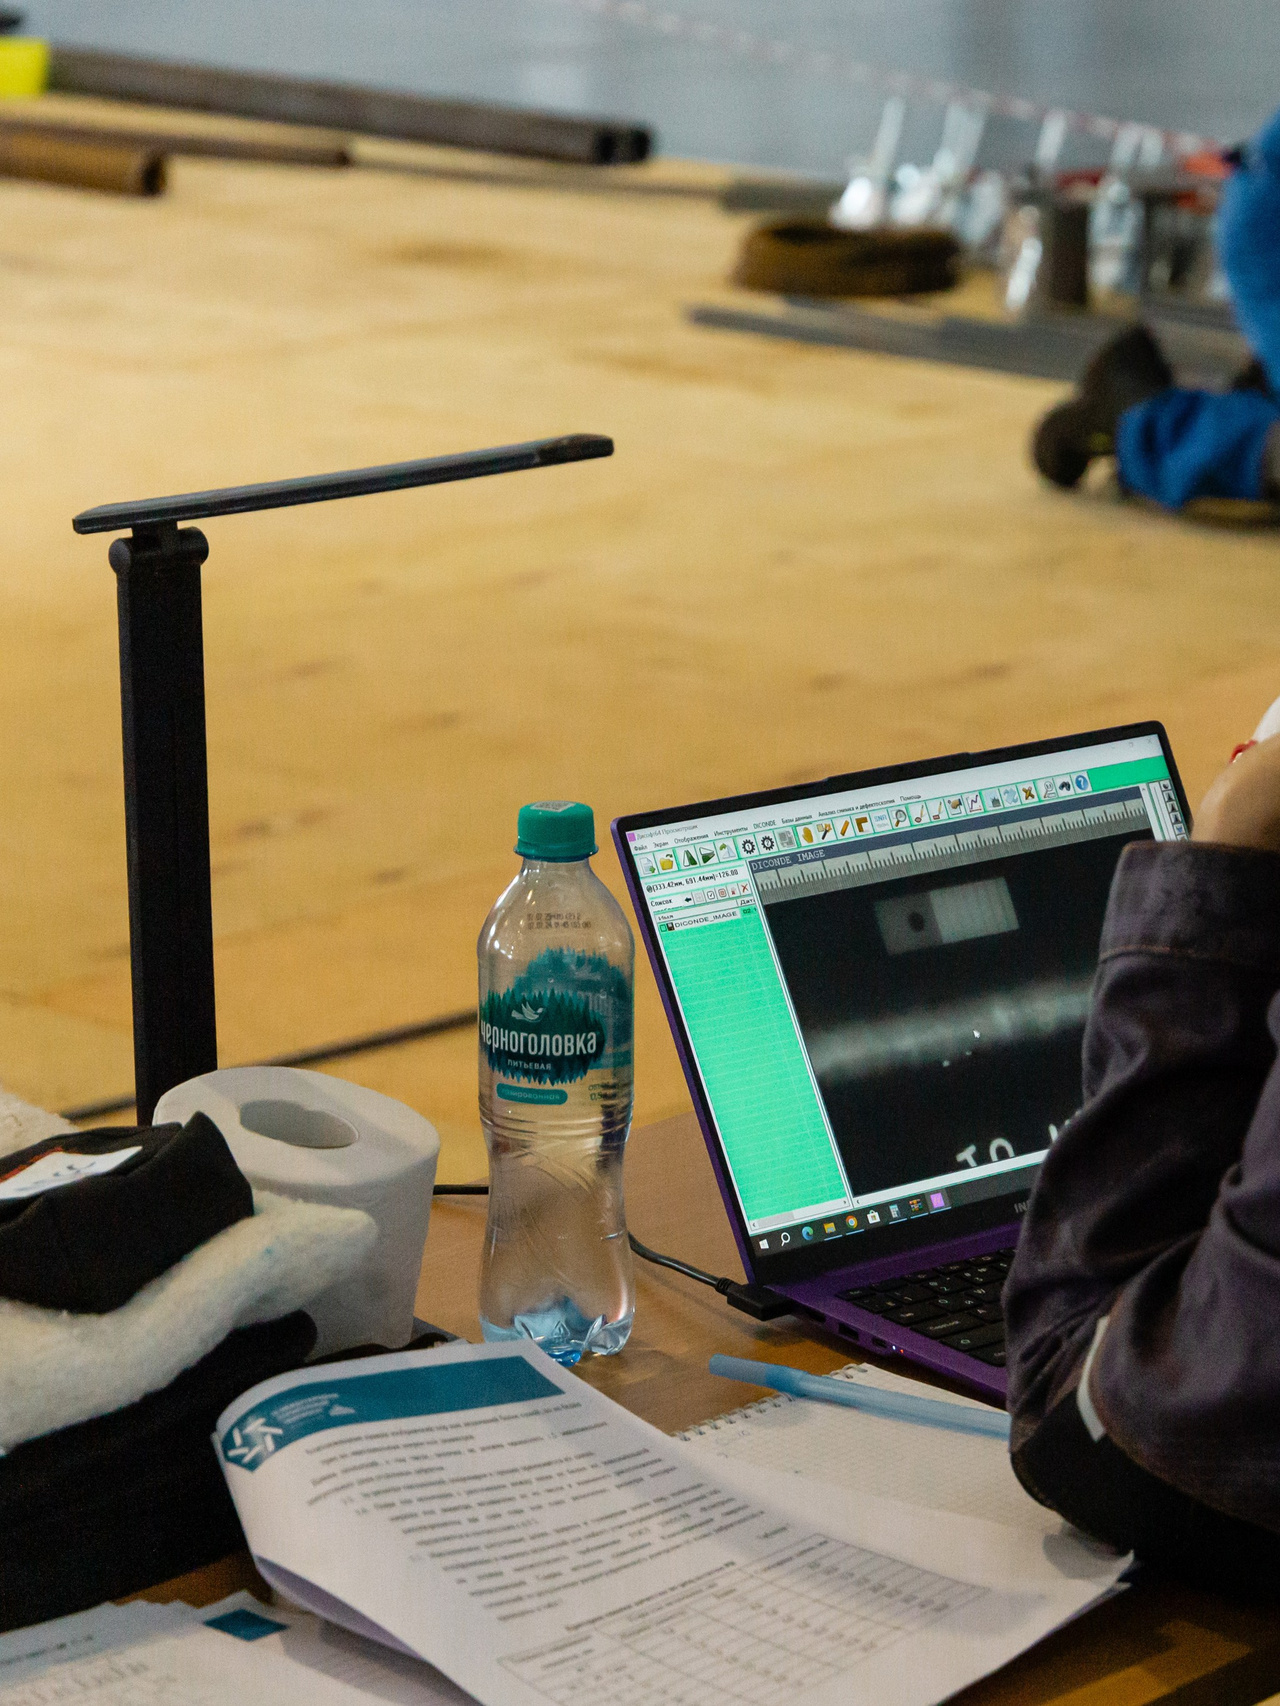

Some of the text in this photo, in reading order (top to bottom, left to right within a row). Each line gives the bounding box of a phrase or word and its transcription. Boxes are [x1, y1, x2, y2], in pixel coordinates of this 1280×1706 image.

[634, 844, 648, 852] Файл
[653, 840, 669, 849] Экран
[674, 833, 709, 844] Отображения
[714, 827, 748, 837] Инструменты
[753, 819, 777, 830] DICONDE
[795, 814, 812, 823] данных
[818, 810, 837, 818] Анализ
[899, 794, 922, 802] Помощь
[752, 849, 826, 871] DICONDE IMAGE
[650, 898, 673, 907] Список
[507, 1058, 552, 1071] ПИТЬЕВАЯ
